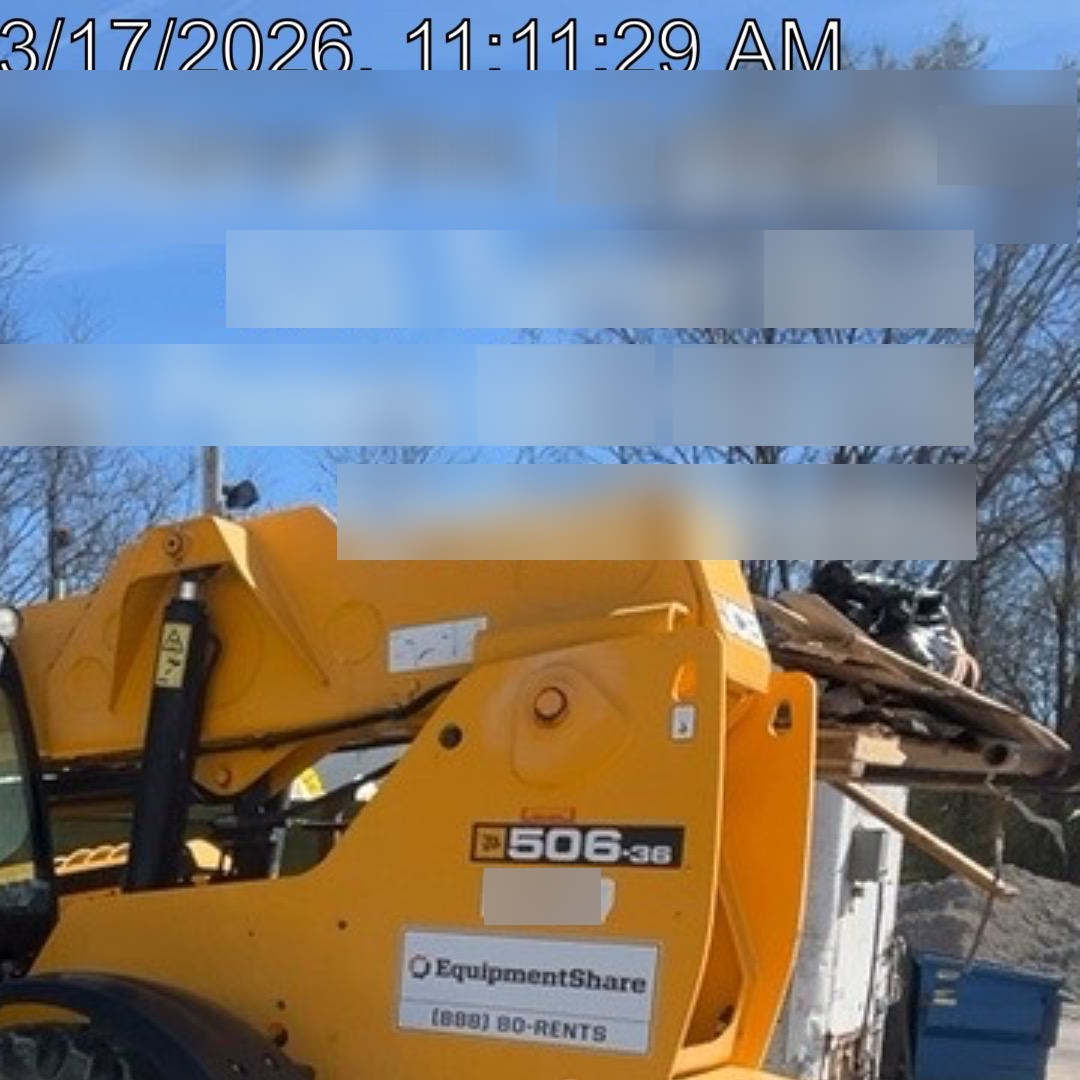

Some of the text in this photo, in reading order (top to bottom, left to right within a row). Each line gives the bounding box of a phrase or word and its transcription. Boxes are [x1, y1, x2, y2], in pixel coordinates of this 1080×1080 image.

[508, 827, 672, 864] 506-36
[435, 958, 647, 993] EquipmentShare
[431, 1008, 490, 1031] (888)
